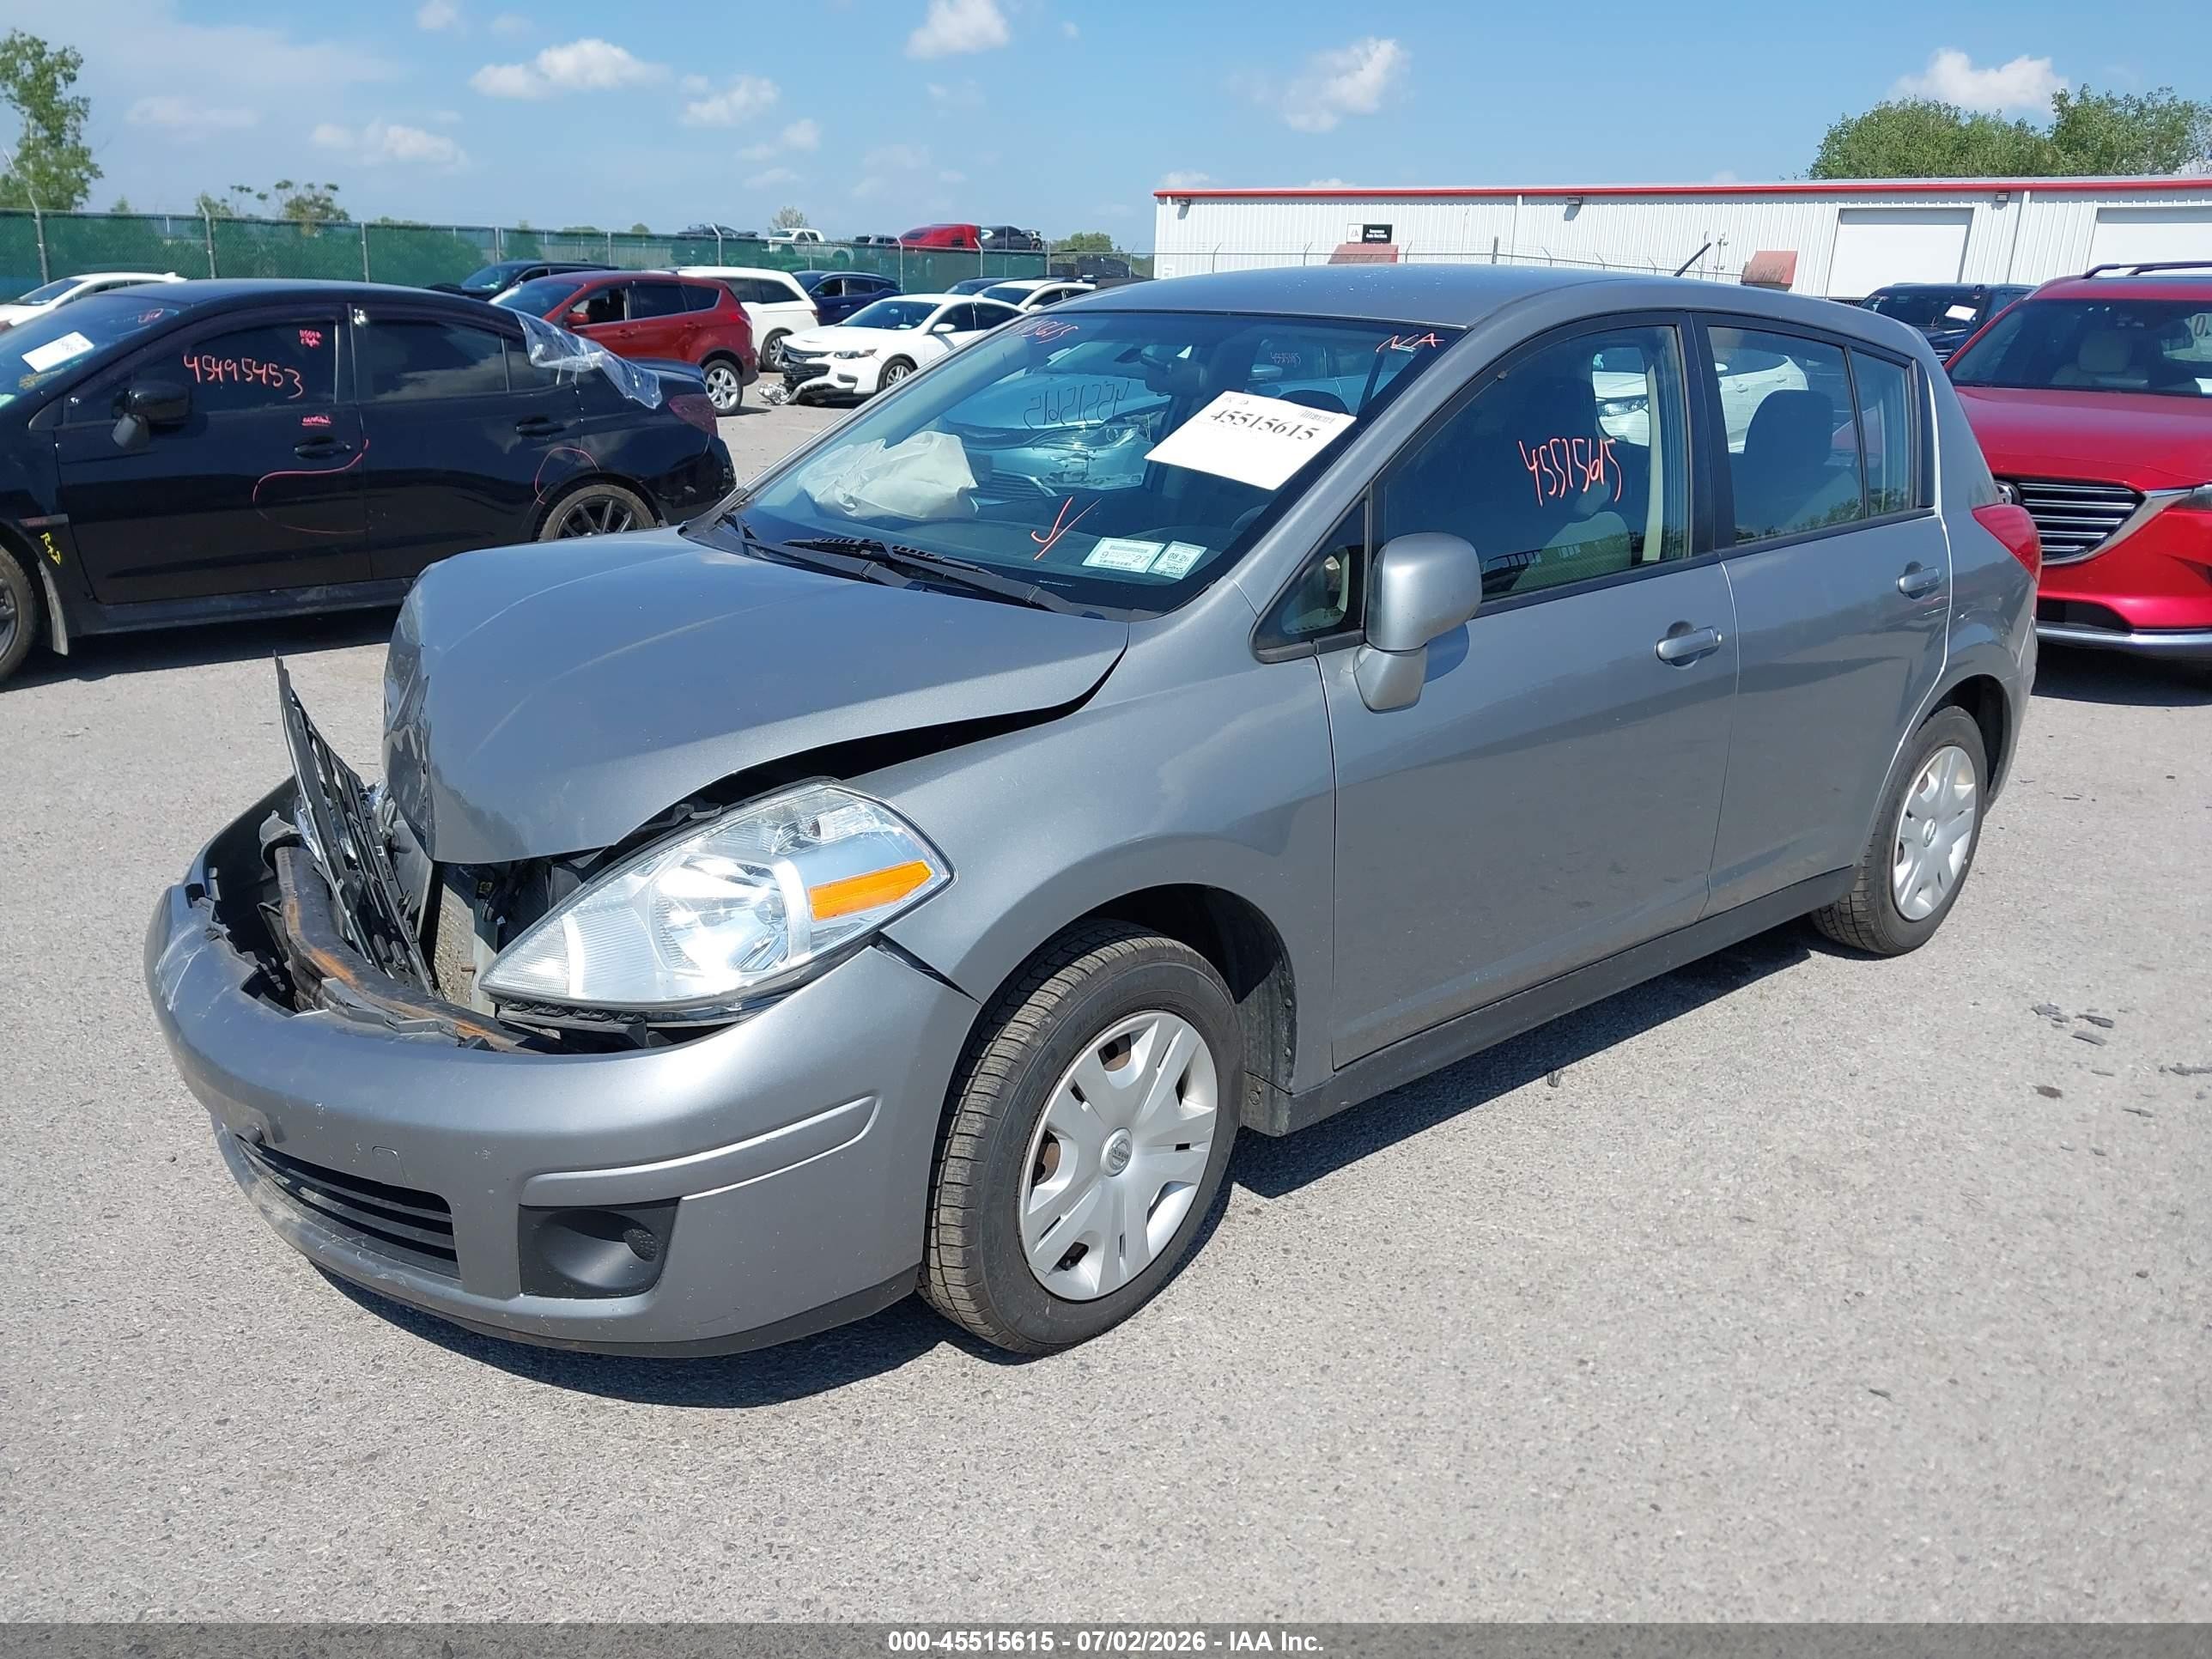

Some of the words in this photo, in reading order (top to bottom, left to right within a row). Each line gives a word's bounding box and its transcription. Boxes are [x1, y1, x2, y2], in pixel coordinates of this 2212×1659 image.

[183, 354, 303, 399] 45495453
[1210, 409, 1322, 441] 45515615
[1518, 437, 1622, 507] 45515615
